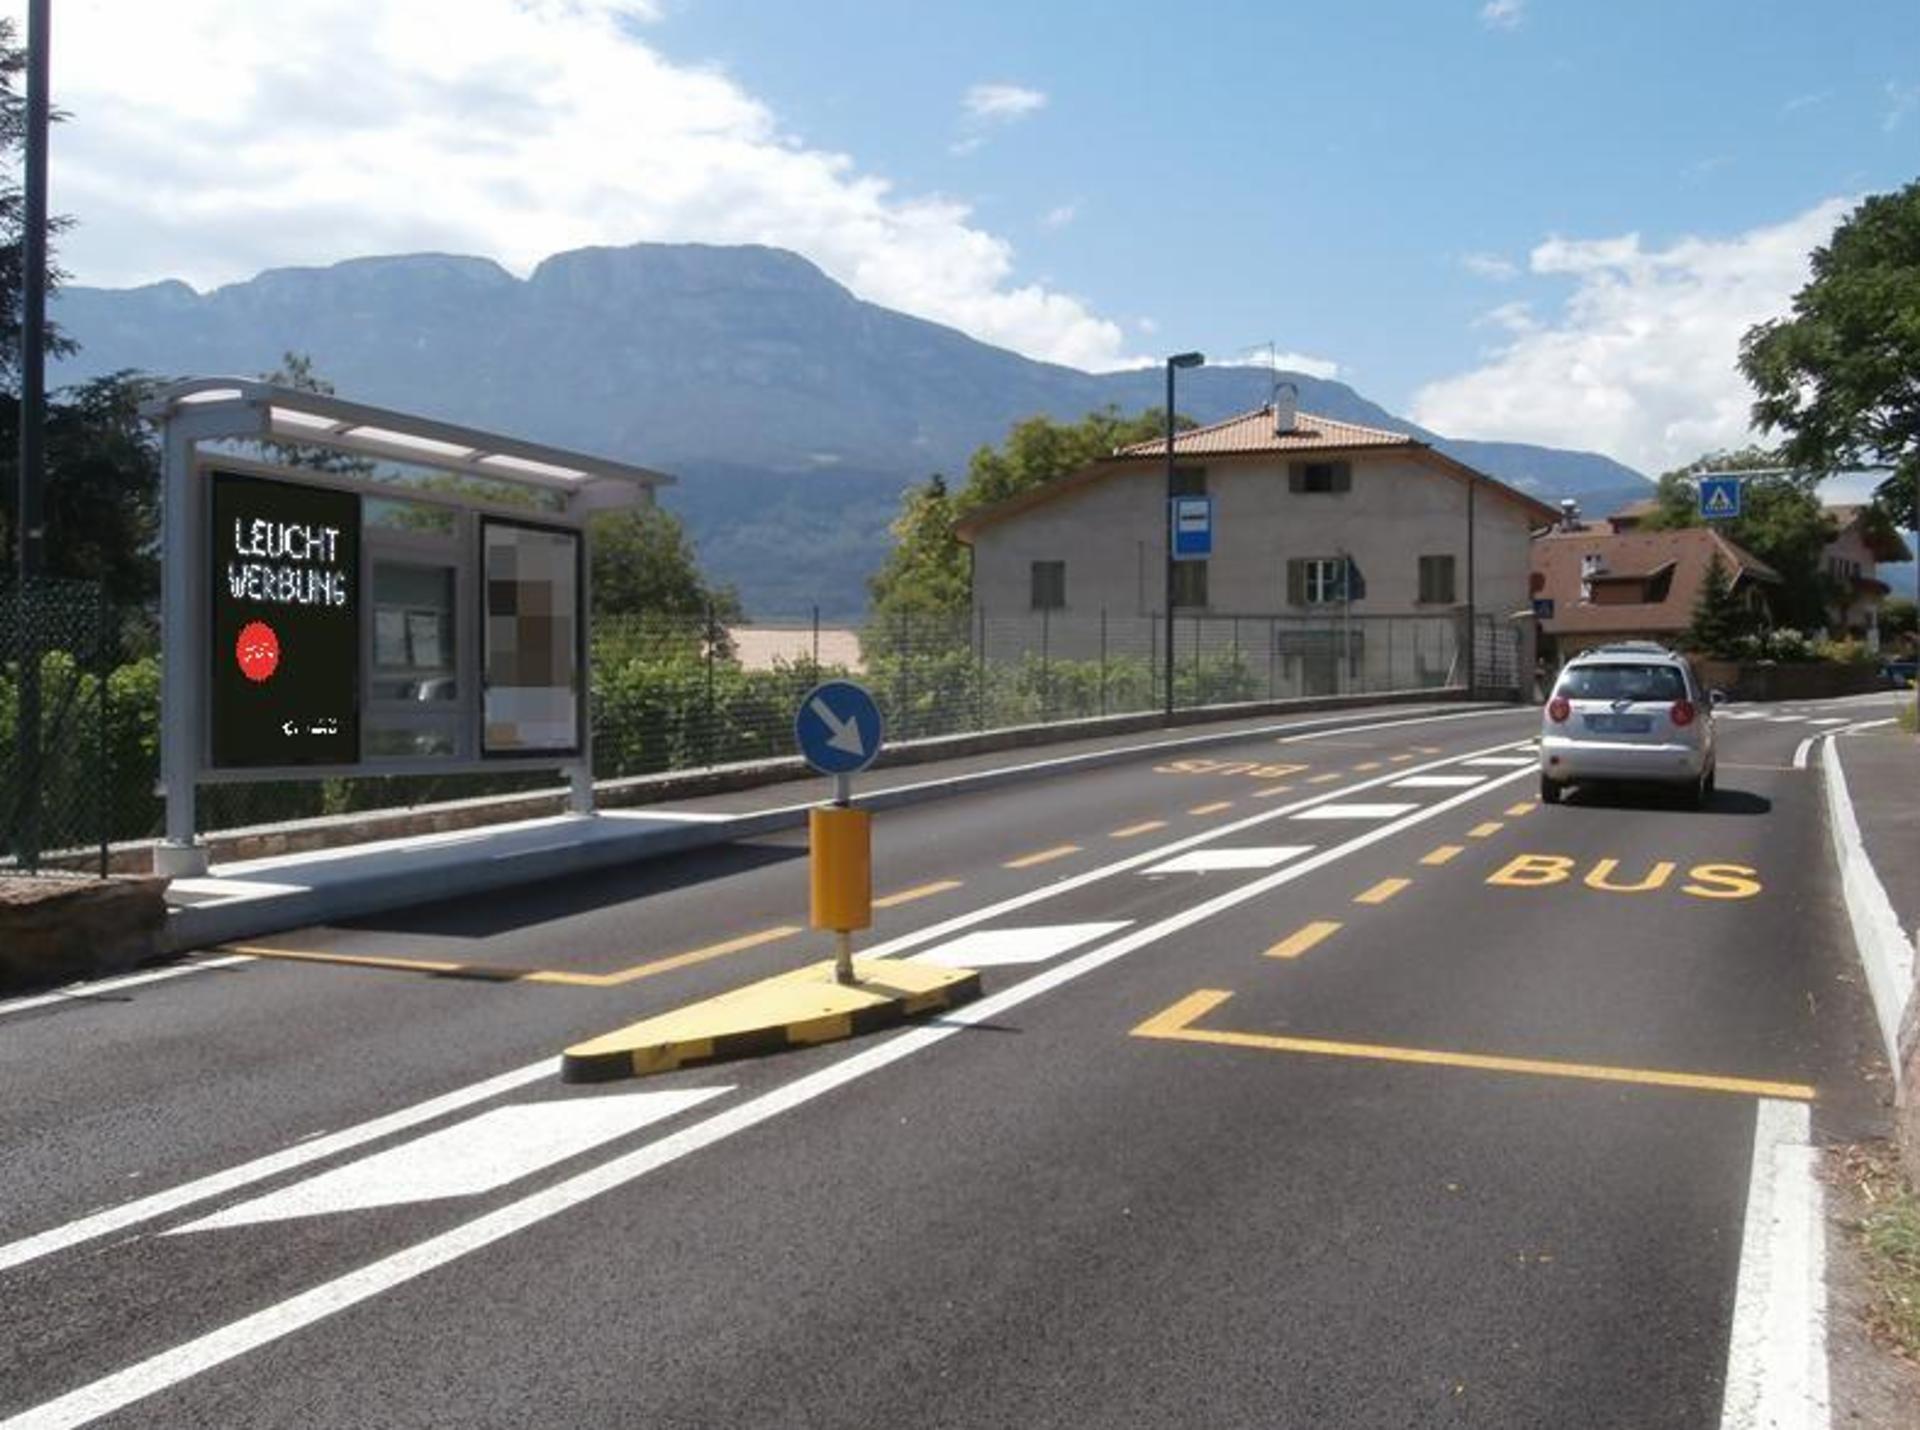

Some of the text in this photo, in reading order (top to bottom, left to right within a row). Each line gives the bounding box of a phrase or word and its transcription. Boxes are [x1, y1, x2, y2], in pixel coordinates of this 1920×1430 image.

[235, 518, 339, 561] LEUCHT
[228, 564, 344, 605] WERBUNG
[1486, 853, 1763, 899] BUS
